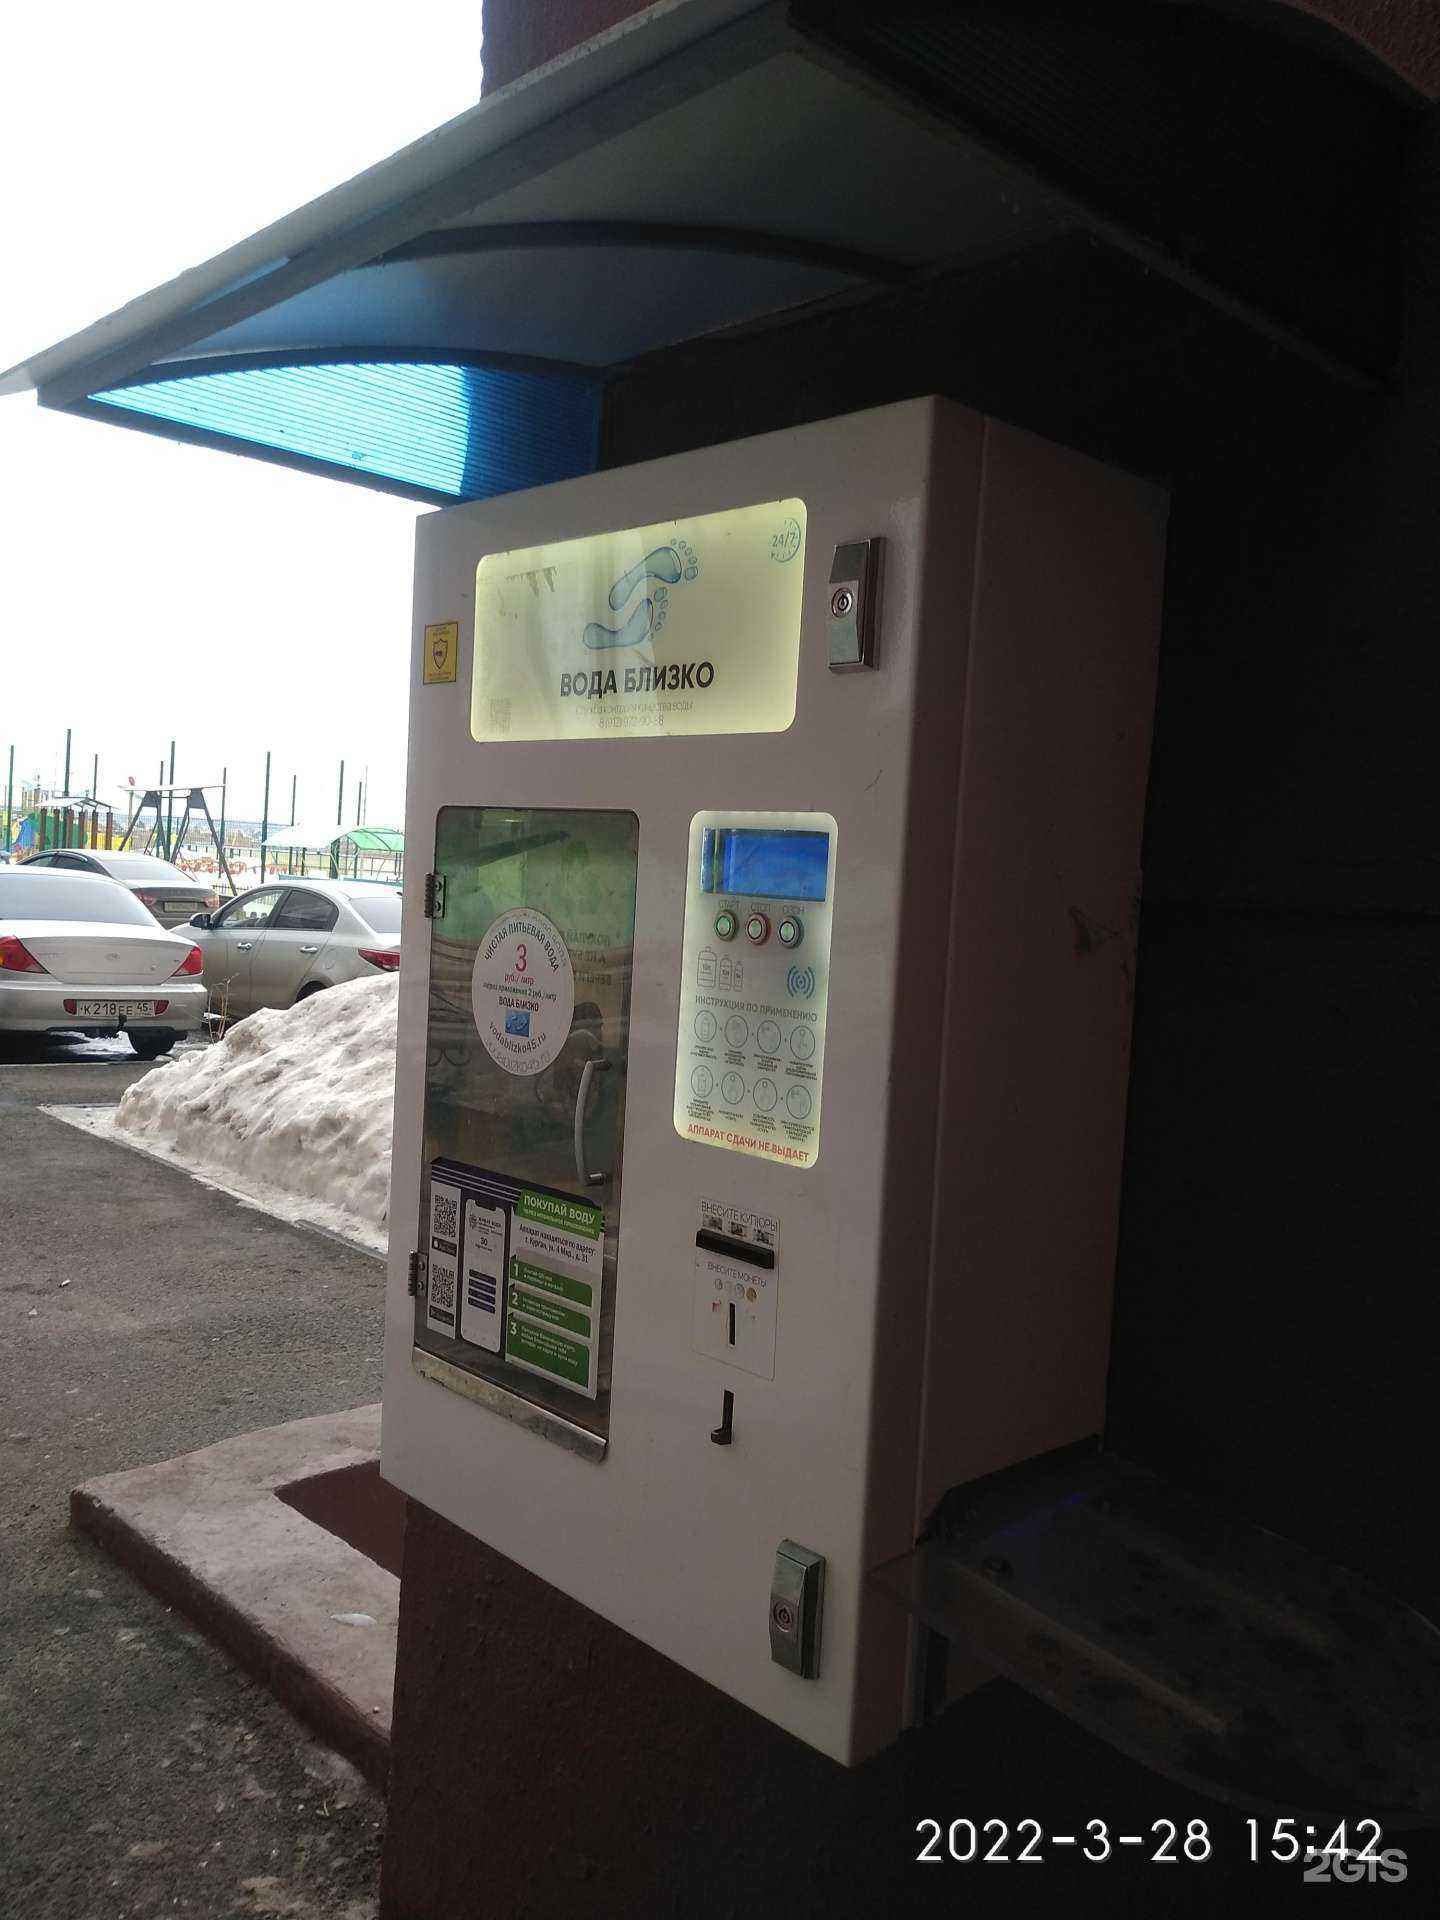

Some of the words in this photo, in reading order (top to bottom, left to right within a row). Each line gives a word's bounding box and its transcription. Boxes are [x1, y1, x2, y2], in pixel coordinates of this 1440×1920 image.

[771, 530, 796, 548] 24/7
[560, 669, 617, 699] ВОДА
[624, 661, 715, 693] БЛИЗКО
[484, 927, 508, 960] ЧИСТАЯ
[508, 921, 545, 944] ПИТЬЕВАЯ
[544, 941, 559, 973] ВОДА
[515, 944, 527, 973] 3
[498, 996, 515, 1009] ВОДА
[515, 999, 539, 1012] БЛИЗКО
[695, 995, 745, 1011] ИНСТРУКЦИЯ
[746, 1003, 759, 1013] ПО
[760, 1005, 818, 1022] ПРИМЕНЕНИЮ
[688, 1123, 724, 1140] АППАРАТ
[726, 1132, 758, 1149] СДАЧИ
[758, 1140, 770, 1151] НЕ
[771, 1145, 809, 1162] ВЫДАЕТ
[524, 1195, 567, 1216] ПОКУПАЙ
[569, 1208, 595, 1225] ВОДУ
[701, 1200, 740, 1223] ВНЕСИТЕ
[740, 1211, 777, 1232] КУПЮРЫ
[514, 1263, 519, 1277] 1
[707, 1261, 738, 1279] ВНЕСИТЕ
[512, 1292, 519, 1305] 2
[510, 1321, 517, 1335] 3
